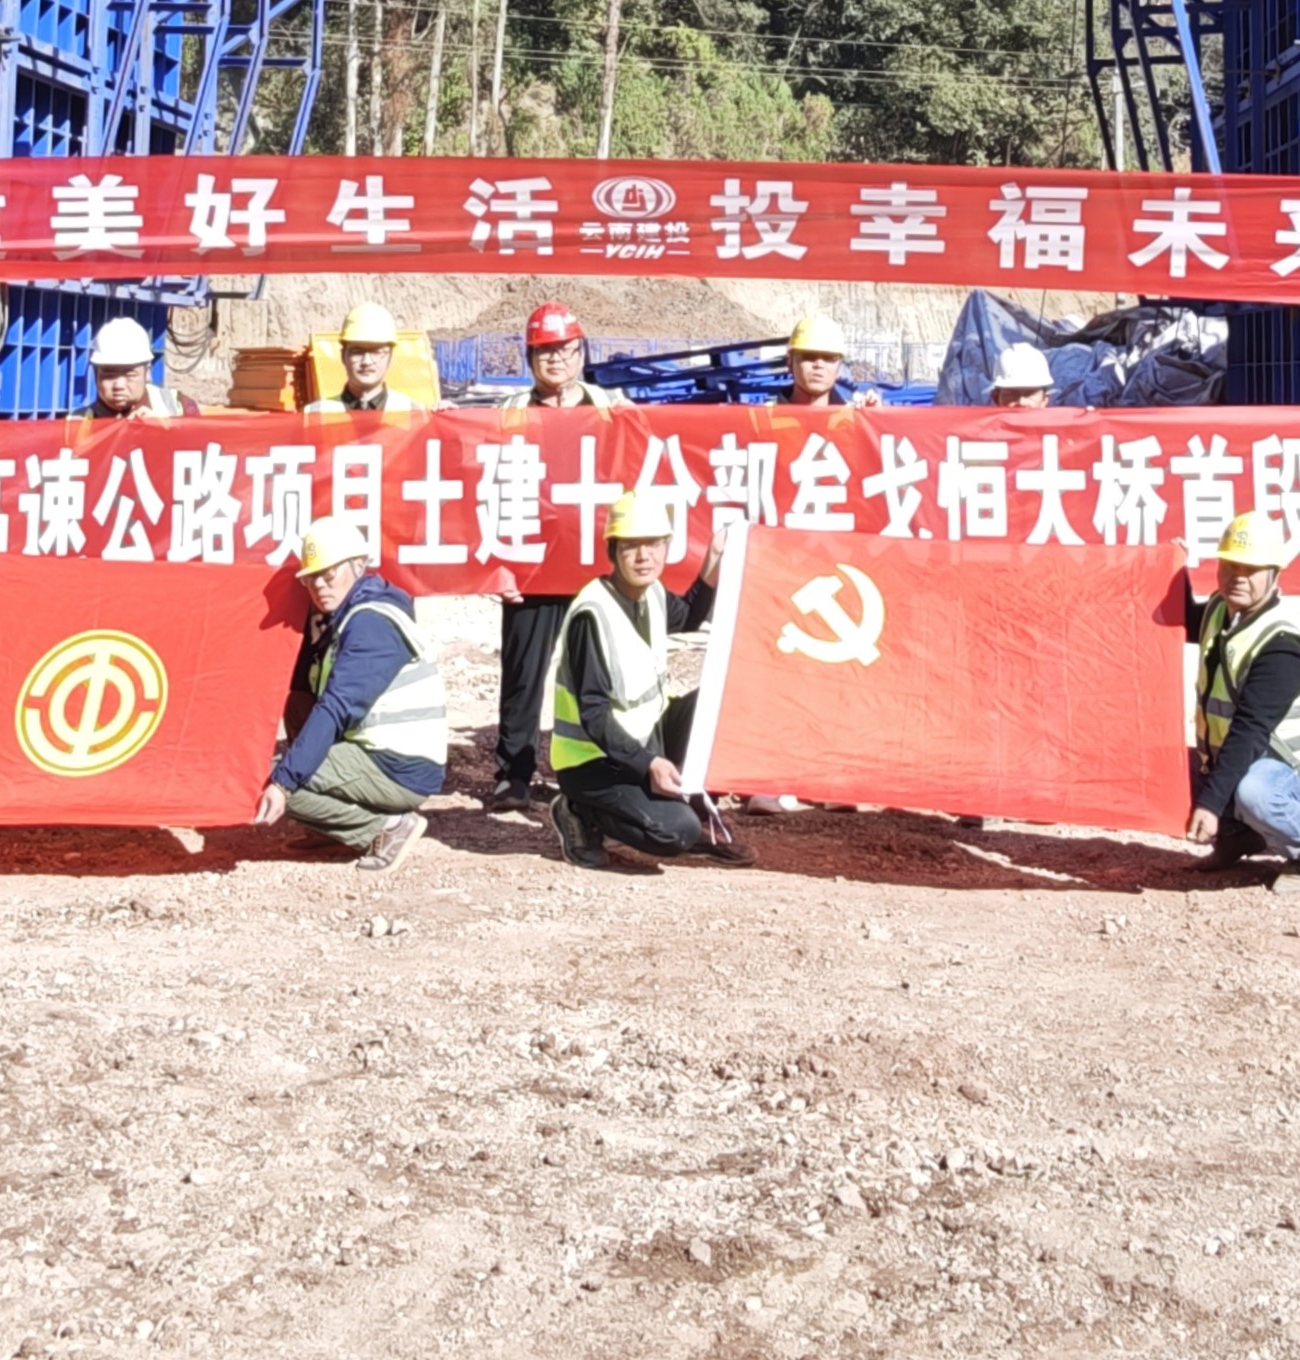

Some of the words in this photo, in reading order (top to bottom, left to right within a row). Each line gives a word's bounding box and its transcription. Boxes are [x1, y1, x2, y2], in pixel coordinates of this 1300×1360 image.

[578, 220, 690, 243] 云南建投
[604, 243, 666, 259] YCIH
